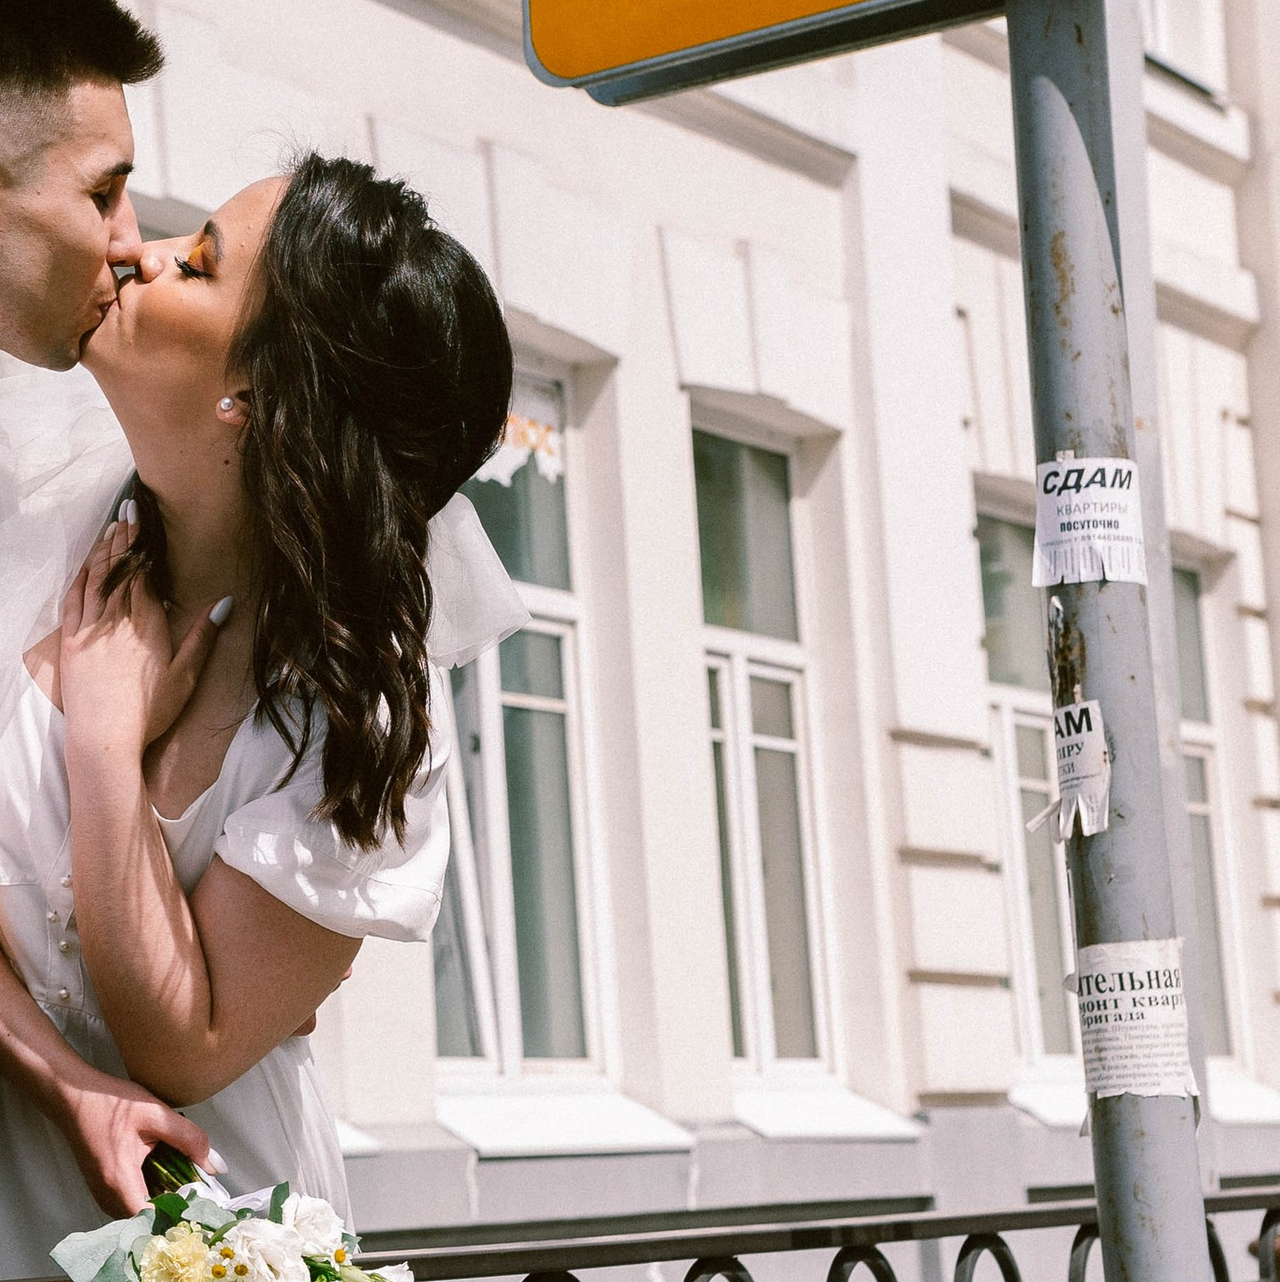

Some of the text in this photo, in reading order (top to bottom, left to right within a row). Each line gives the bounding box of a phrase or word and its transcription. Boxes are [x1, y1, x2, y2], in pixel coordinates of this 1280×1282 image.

[1042, 467, 1132, 496] СДАМ
[1056, 502, 1128, 516] КВАРТИРЫ
[1060, 520, 1120, 533] ПОСУТОЧНО
